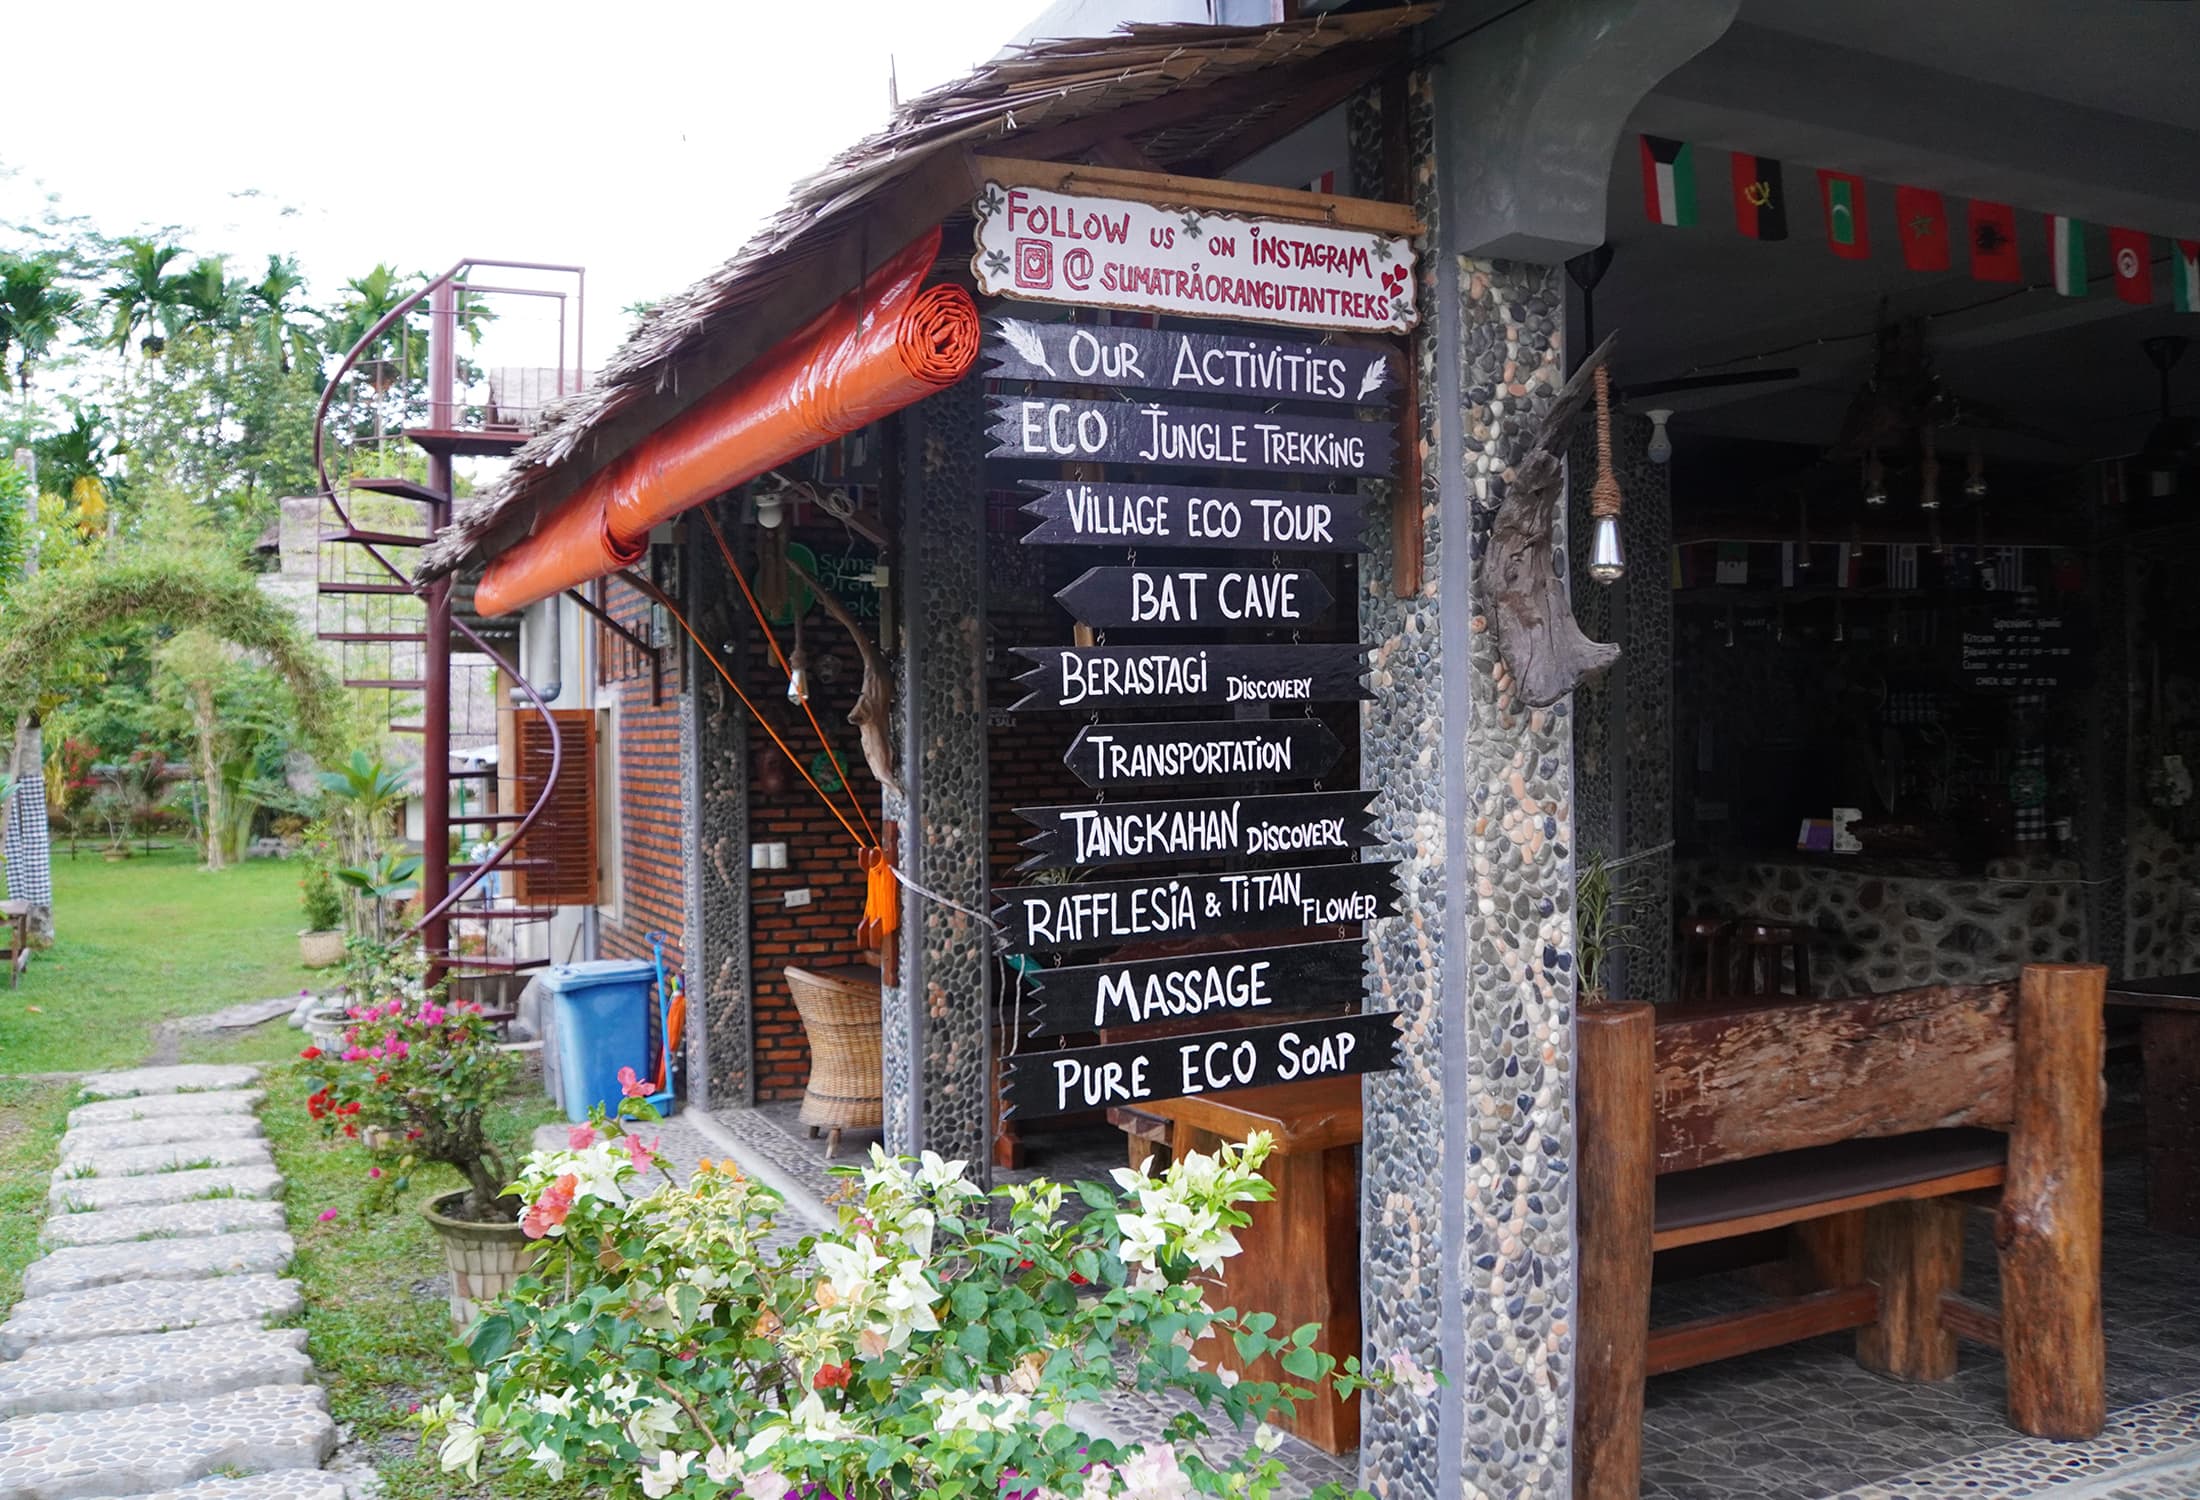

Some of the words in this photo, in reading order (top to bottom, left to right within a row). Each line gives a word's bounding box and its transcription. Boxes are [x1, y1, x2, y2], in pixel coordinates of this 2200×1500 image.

[1007, 191, 1130, 245] FOLLOW
[1068, 330, 1144, 379] OUR
[1021, 402, 1107, 454] ECO
[1139, 404, 1247, 462] JUNGLE
[1188, 499, 1241, 538] ECO
[1251, 500, 1333, 543] TOUR
[1132, 573, 1207, 622] BAT
[1218, 574, 1299, 618] CAVE
[1060, 801, 1240, 863] TANGKAHAN
[1205, 892, 1221, 918] &
[1303, 891, 1377, 926] FLOWER
[1095, 962, 1272, 1026] MASSAGE
[1053, 1056, 1151, 1109] PURE
[1179, 1041, 1256, 1097] ECO
[1277, 1032, 1355, 1080] SOAP
